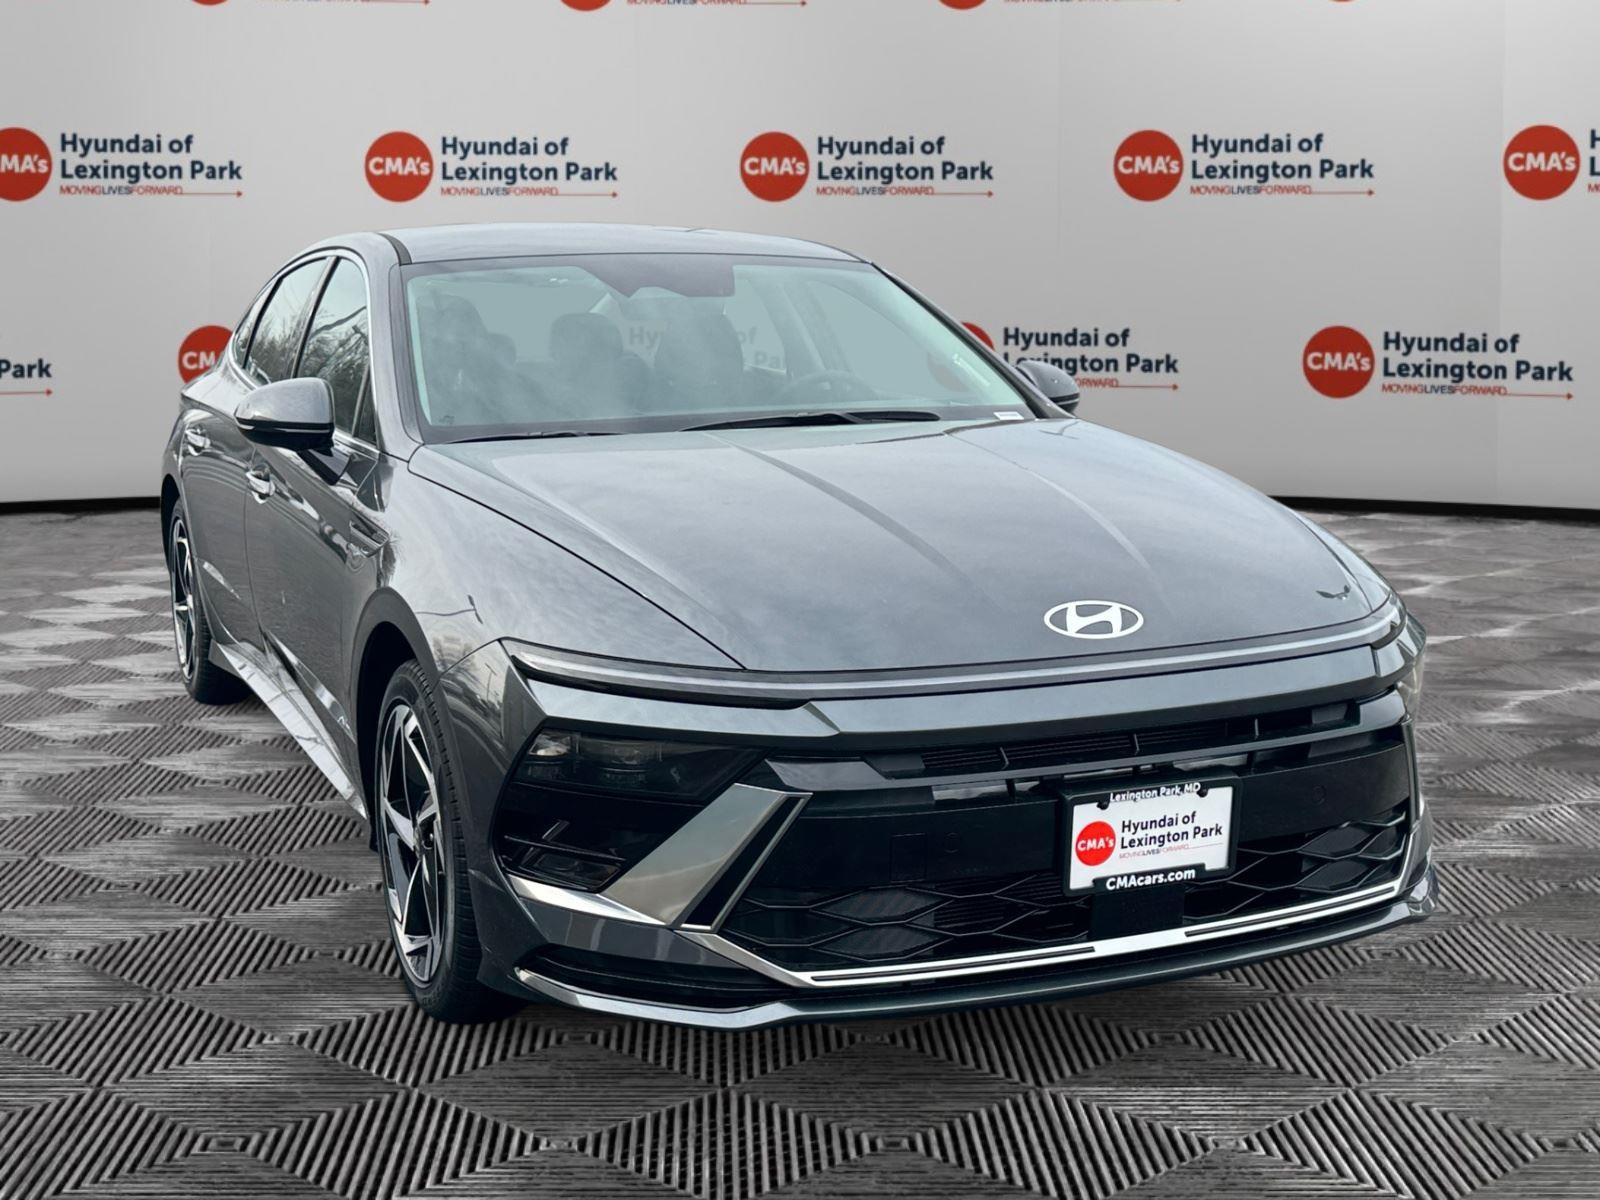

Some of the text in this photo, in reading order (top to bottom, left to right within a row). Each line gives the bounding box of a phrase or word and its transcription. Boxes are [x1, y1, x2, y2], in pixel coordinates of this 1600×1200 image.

[60, 133, 194, 158] Hyundai of
[441, 136, 569, 160] Hyundai of
[817, 136, 945, 160] Hyundai of
[1191, 133, 1324, 158] Hyundai of
[0, 154, 49, 174] MA's
[60, 159, 242, 184] Lexington Park
[368, 156, 431, 176] CMA's
[441, 162, 618, 185] Lexington Park
[744, 157, 807, 176] CMA's
[817, 161, 994, 185] Lexington Park
[1117, 156, 1180, 175] CMA's
[1191, 159, 1374, 184] Lexington Park
[1507, 152, 1577, 172] CMA's
[1003, 327, 1130, 351] Hyundai of
[1383, 331, 1520, 356] Hyundai of
[0, 358, 52, 378] Park
[1126, 353, 1179, 373] Park
[1307, 352, 1372, 372] CMA's
[1383, 357, 1573, 383] Lexington Park
[1109, 789, 1158, 802] Lexington
[1183, 782, 1201, 794] MD
[1121, 811, 1197, 835] Hyundai of
[1077, 836, 1115, 851] CMA's
[1120, 824, 1223, 849] Lexington Park
[1105, 868, 1196, 890] CMAcars.com
